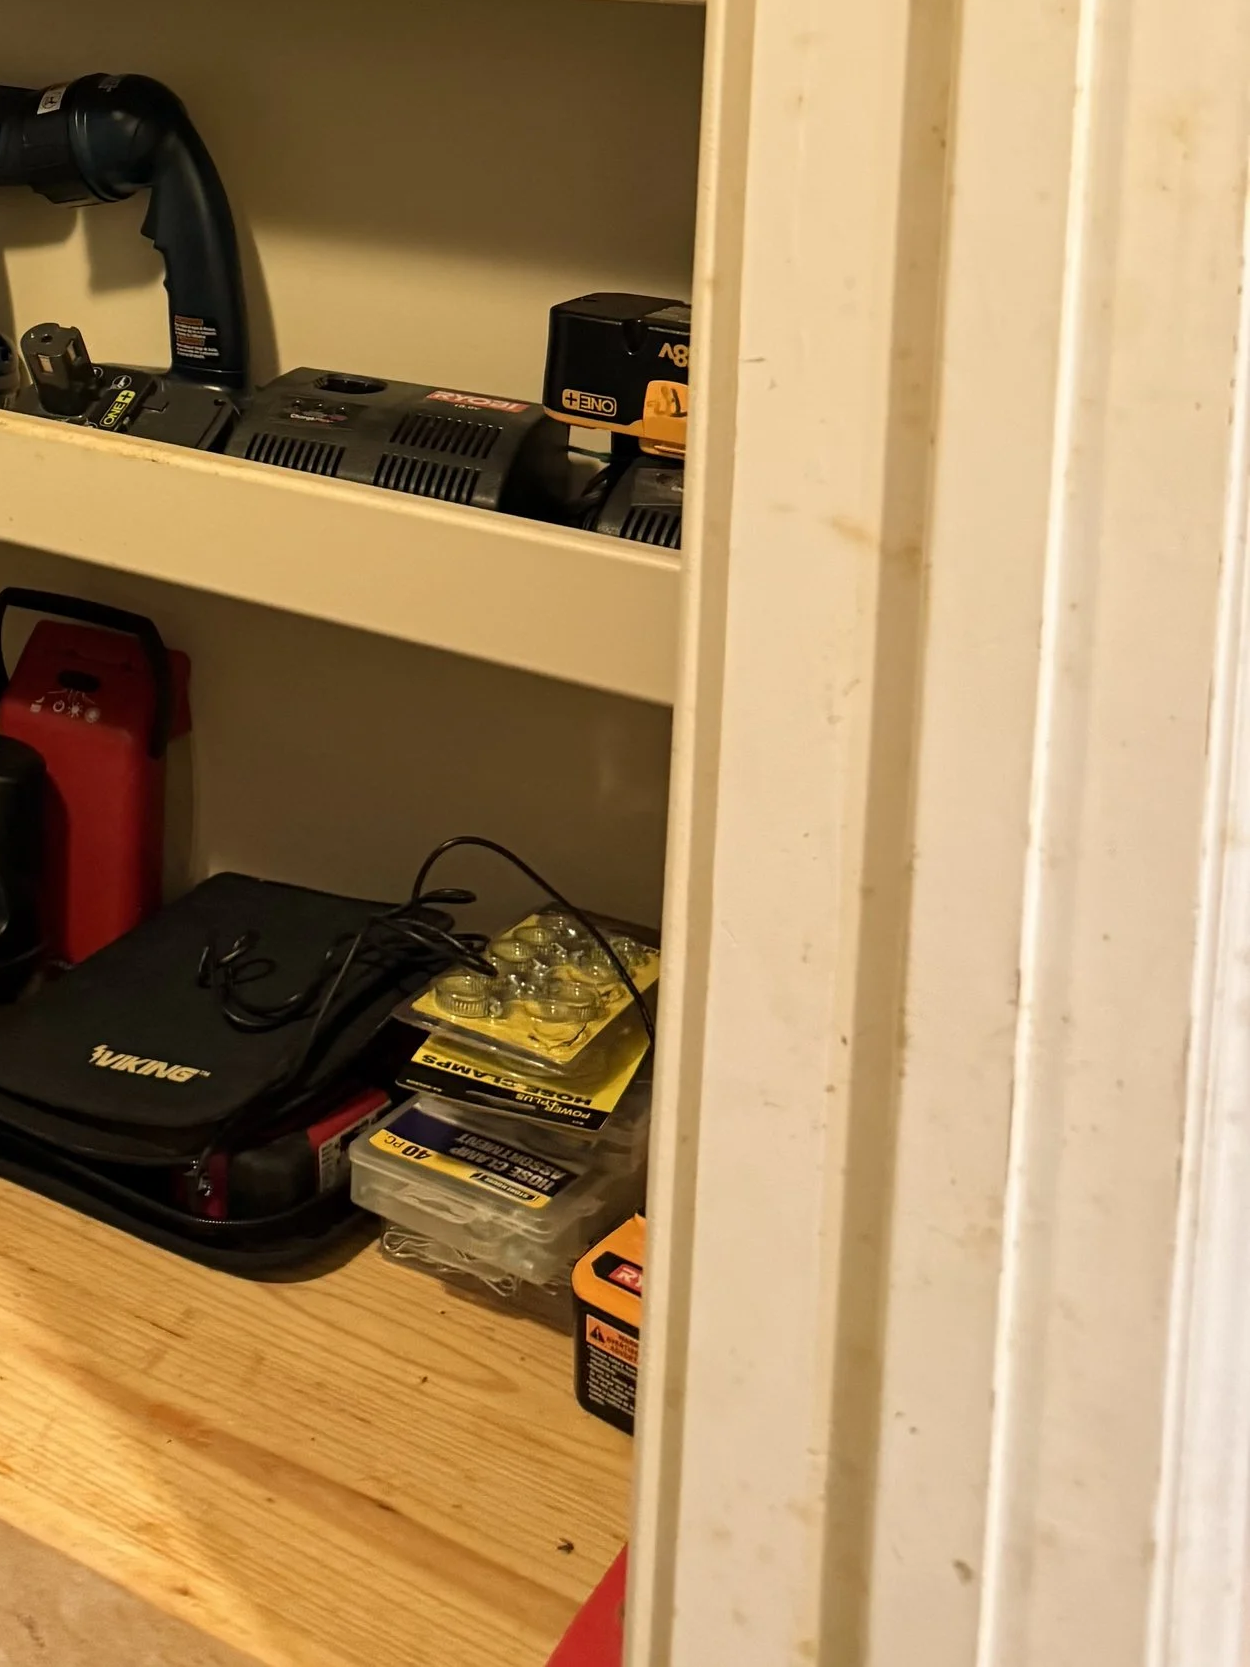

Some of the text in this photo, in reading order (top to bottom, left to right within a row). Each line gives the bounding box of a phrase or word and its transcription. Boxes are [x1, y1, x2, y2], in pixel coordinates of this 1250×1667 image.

[95, 1048, 200, 1083] VIKING
[401, 1145, 432, 1160] 40
[449, 1146, 556, 1192] HOSE CLAMP
[455, 1133, 568, 1180] ASSORTMENT
